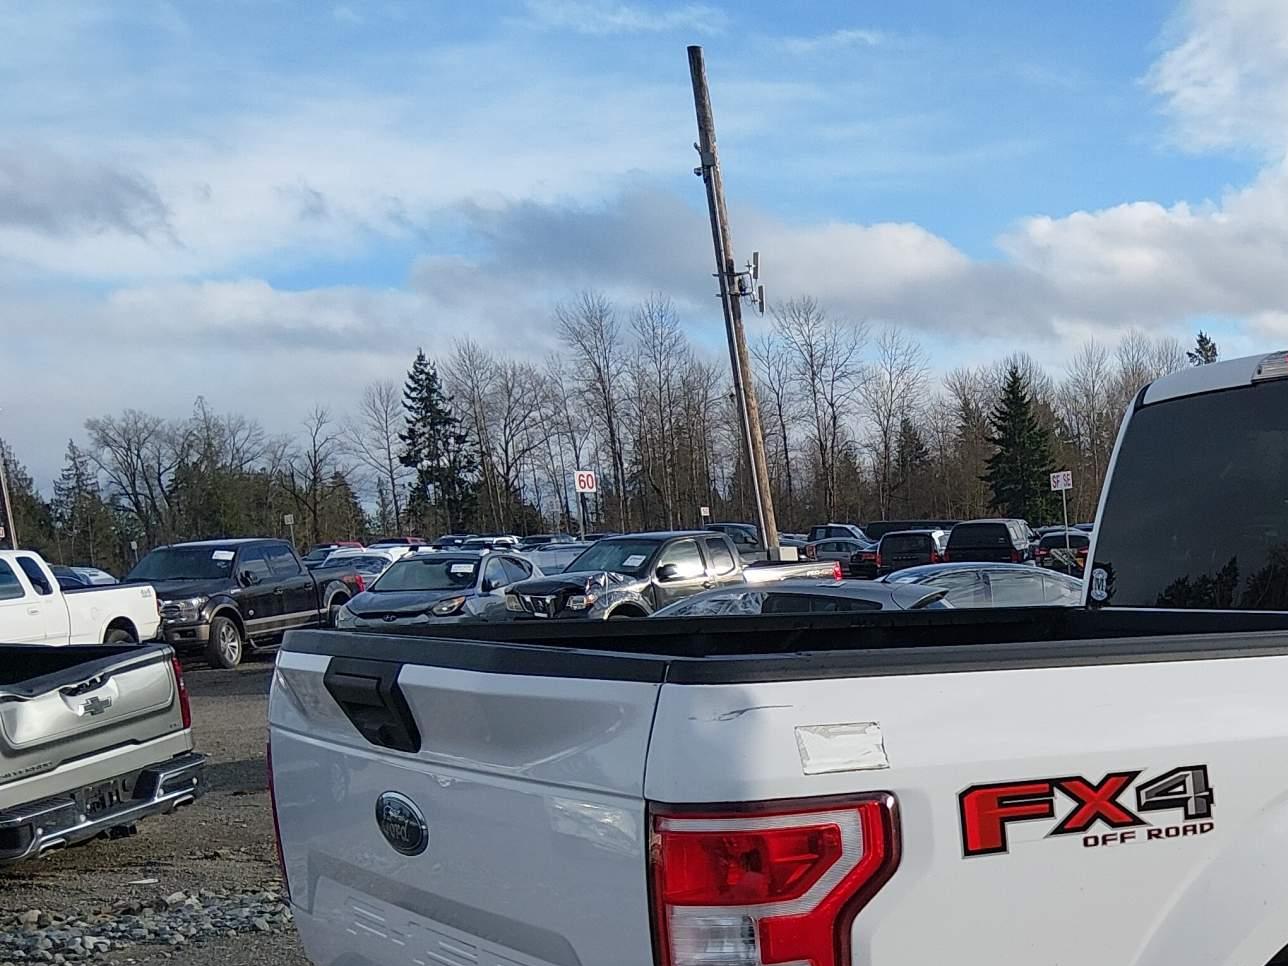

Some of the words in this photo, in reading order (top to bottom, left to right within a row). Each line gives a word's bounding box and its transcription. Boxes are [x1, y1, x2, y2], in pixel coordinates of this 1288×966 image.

[578, 473, 594, 490] 60
[957, 763, 1215, 858] FX4
[1083, 830, 1137, 848] OFF
[1147, 821, 1215, 841] ROAD
